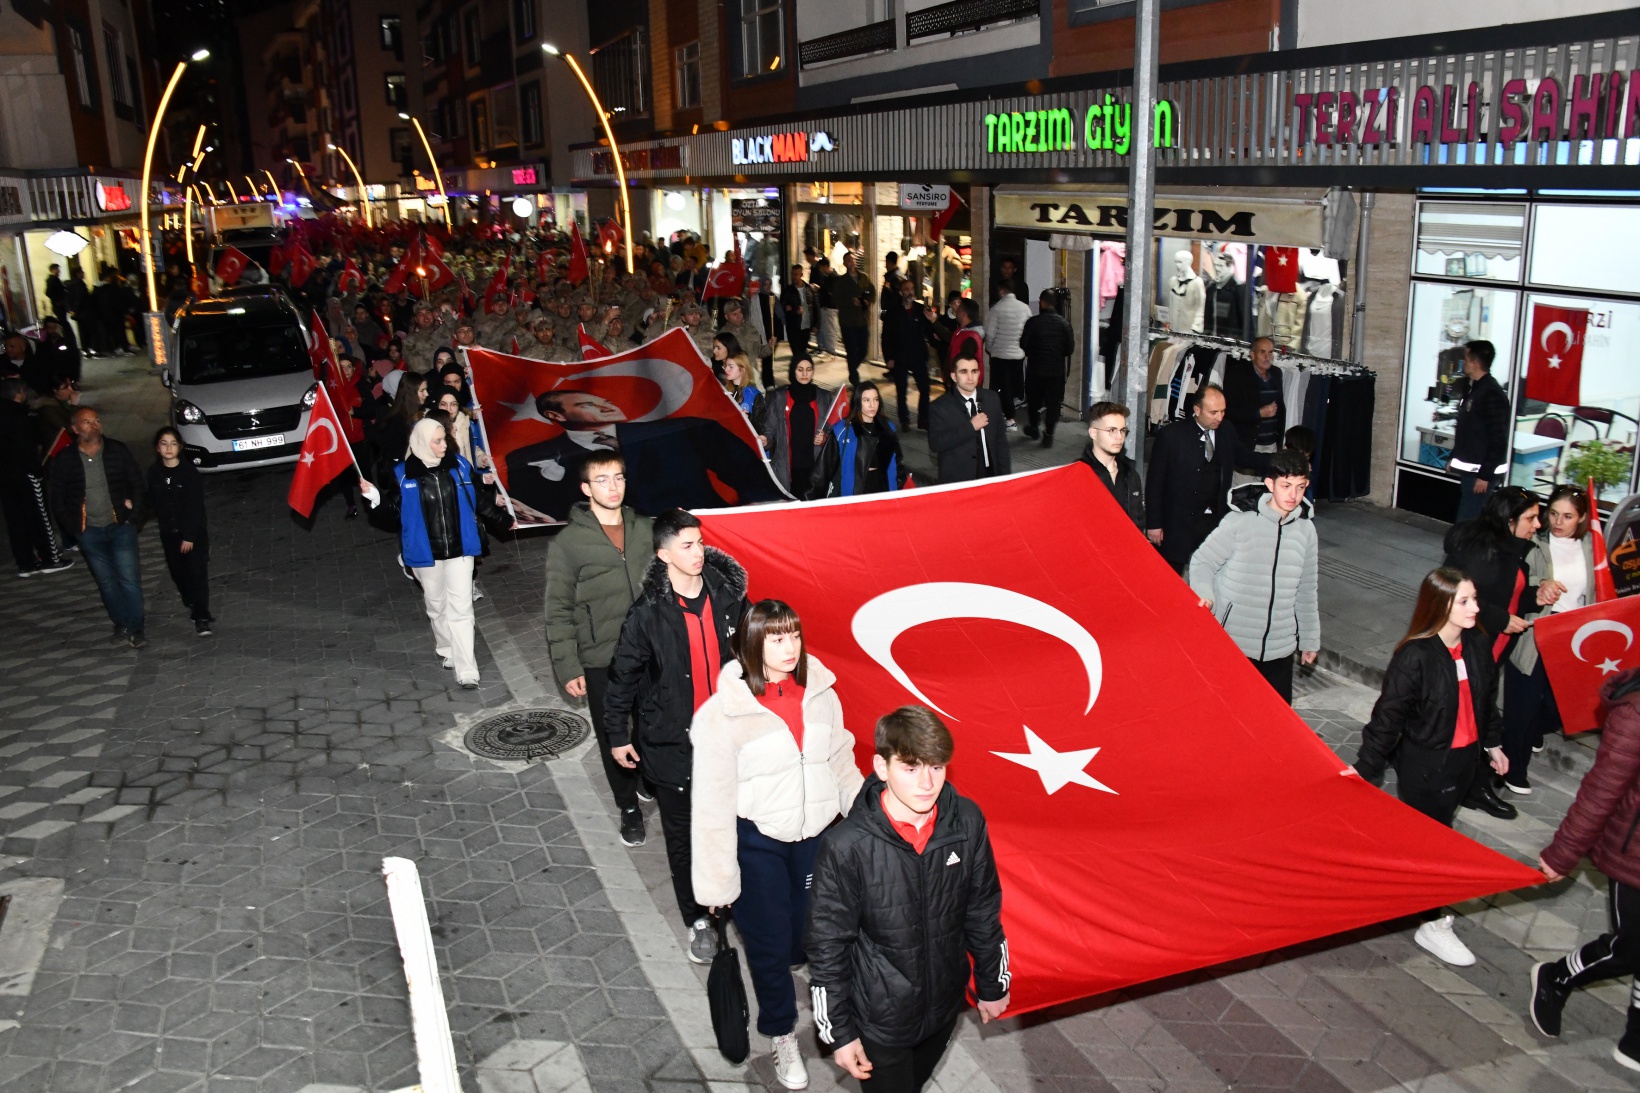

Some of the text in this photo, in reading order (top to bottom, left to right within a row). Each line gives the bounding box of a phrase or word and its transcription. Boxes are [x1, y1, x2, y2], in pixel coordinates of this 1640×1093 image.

[1295, 86, 1398, 144] TERZİ
[1412, 81, 1477, 143] ALİ
[985, 107, 1072, 153] TARZIM
[732, 131, 807, 165] BLACKMAN
[907, 192, 947, 201] SANSIRO
[266, 436, 284, 446] 999
